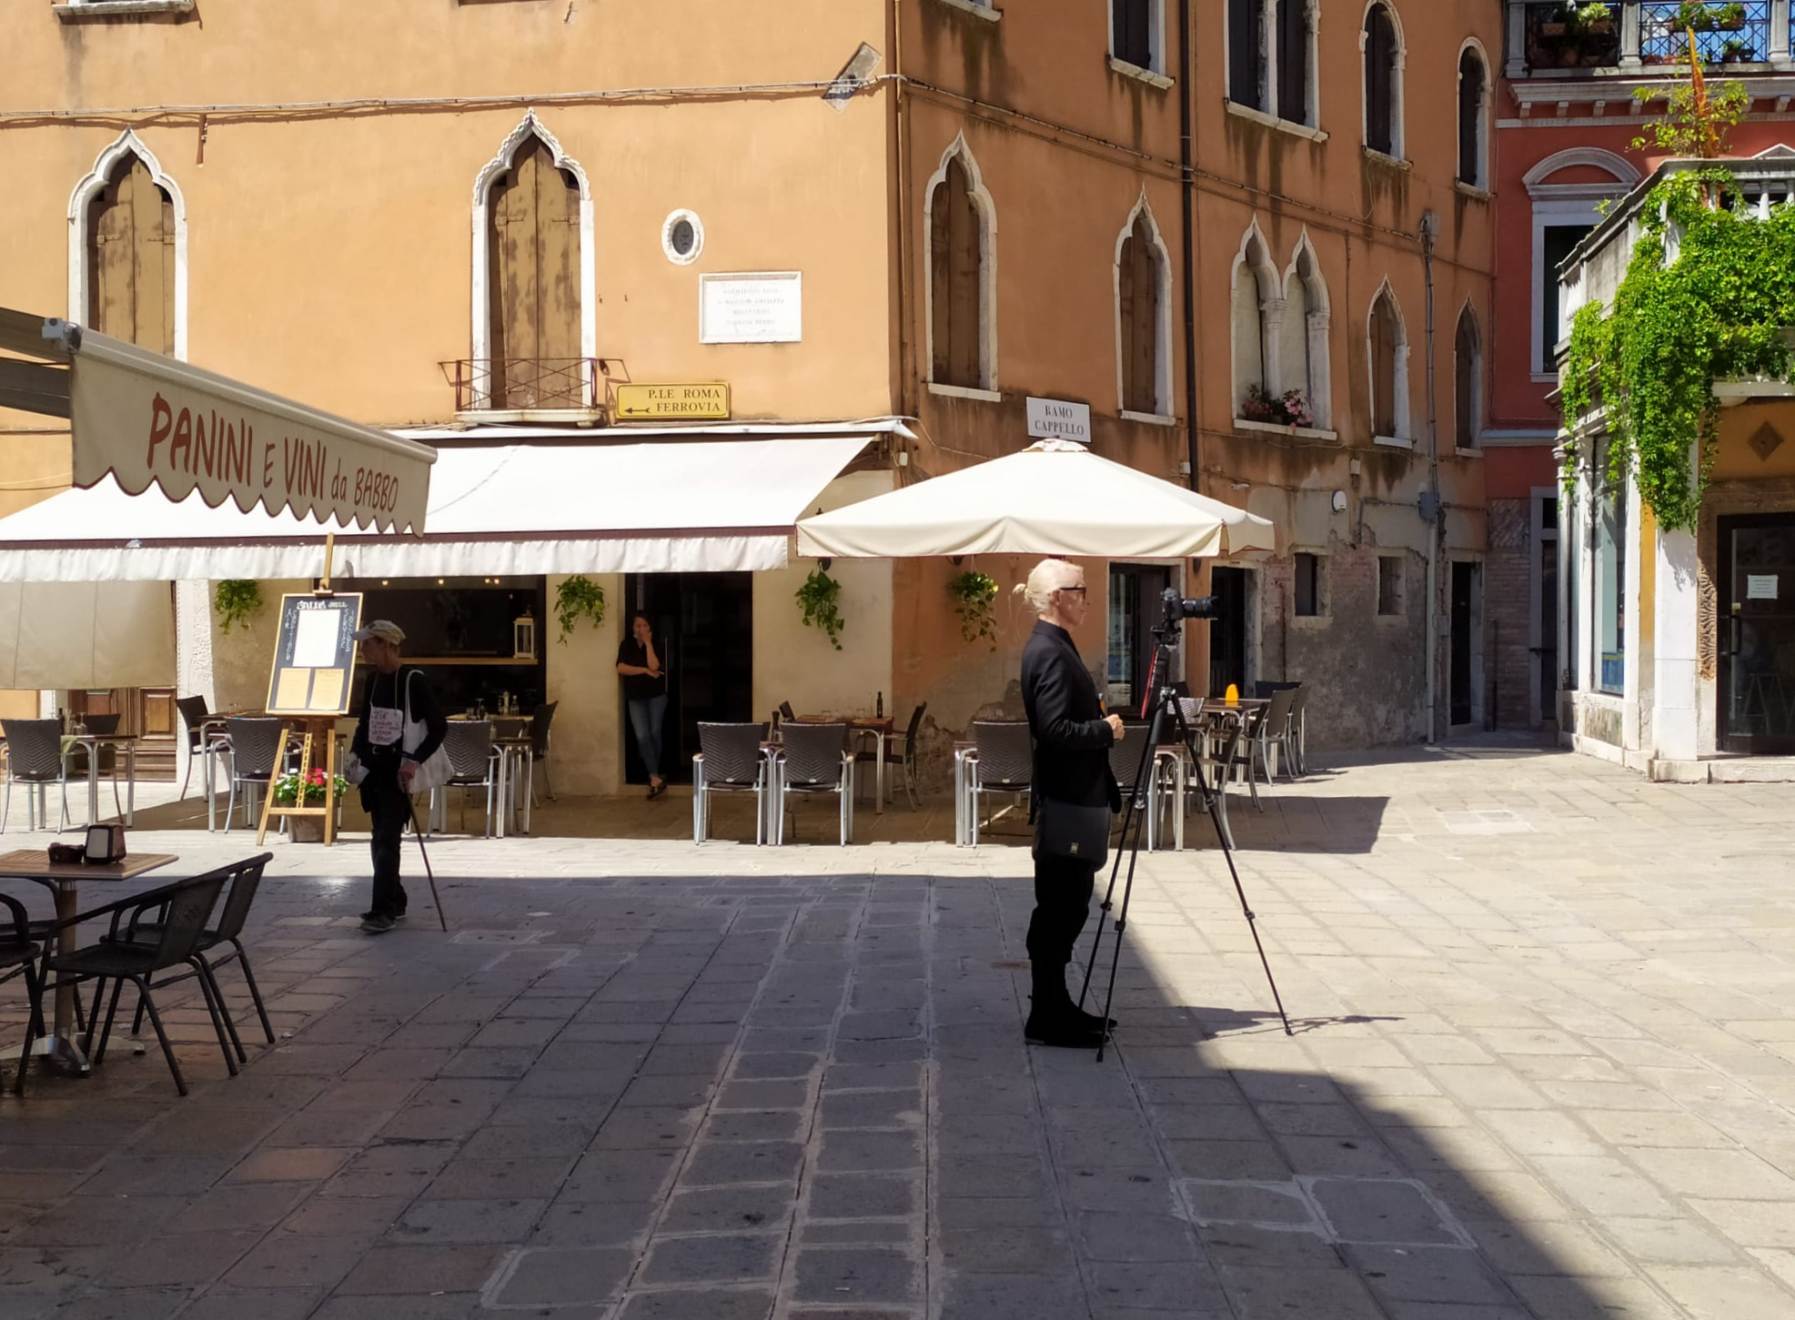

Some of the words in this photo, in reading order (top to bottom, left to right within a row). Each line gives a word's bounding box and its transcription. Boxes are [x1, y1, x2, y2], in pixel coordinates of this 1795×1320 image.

[684, 388, 720, 399] ROMA
[657, 402, 720, 412] FERROVIA
[1045, 405, 1073, 419] RAMO
[1034, 420, 1085, 436] CAPPELLO
[147, 392, 253, 487] PANINI
[264, 443, 276, 488] E
[284, 437, 327, 500] VINI
[331, 457, 348, 502] da
[354, 467, 399, 513] BABBO
